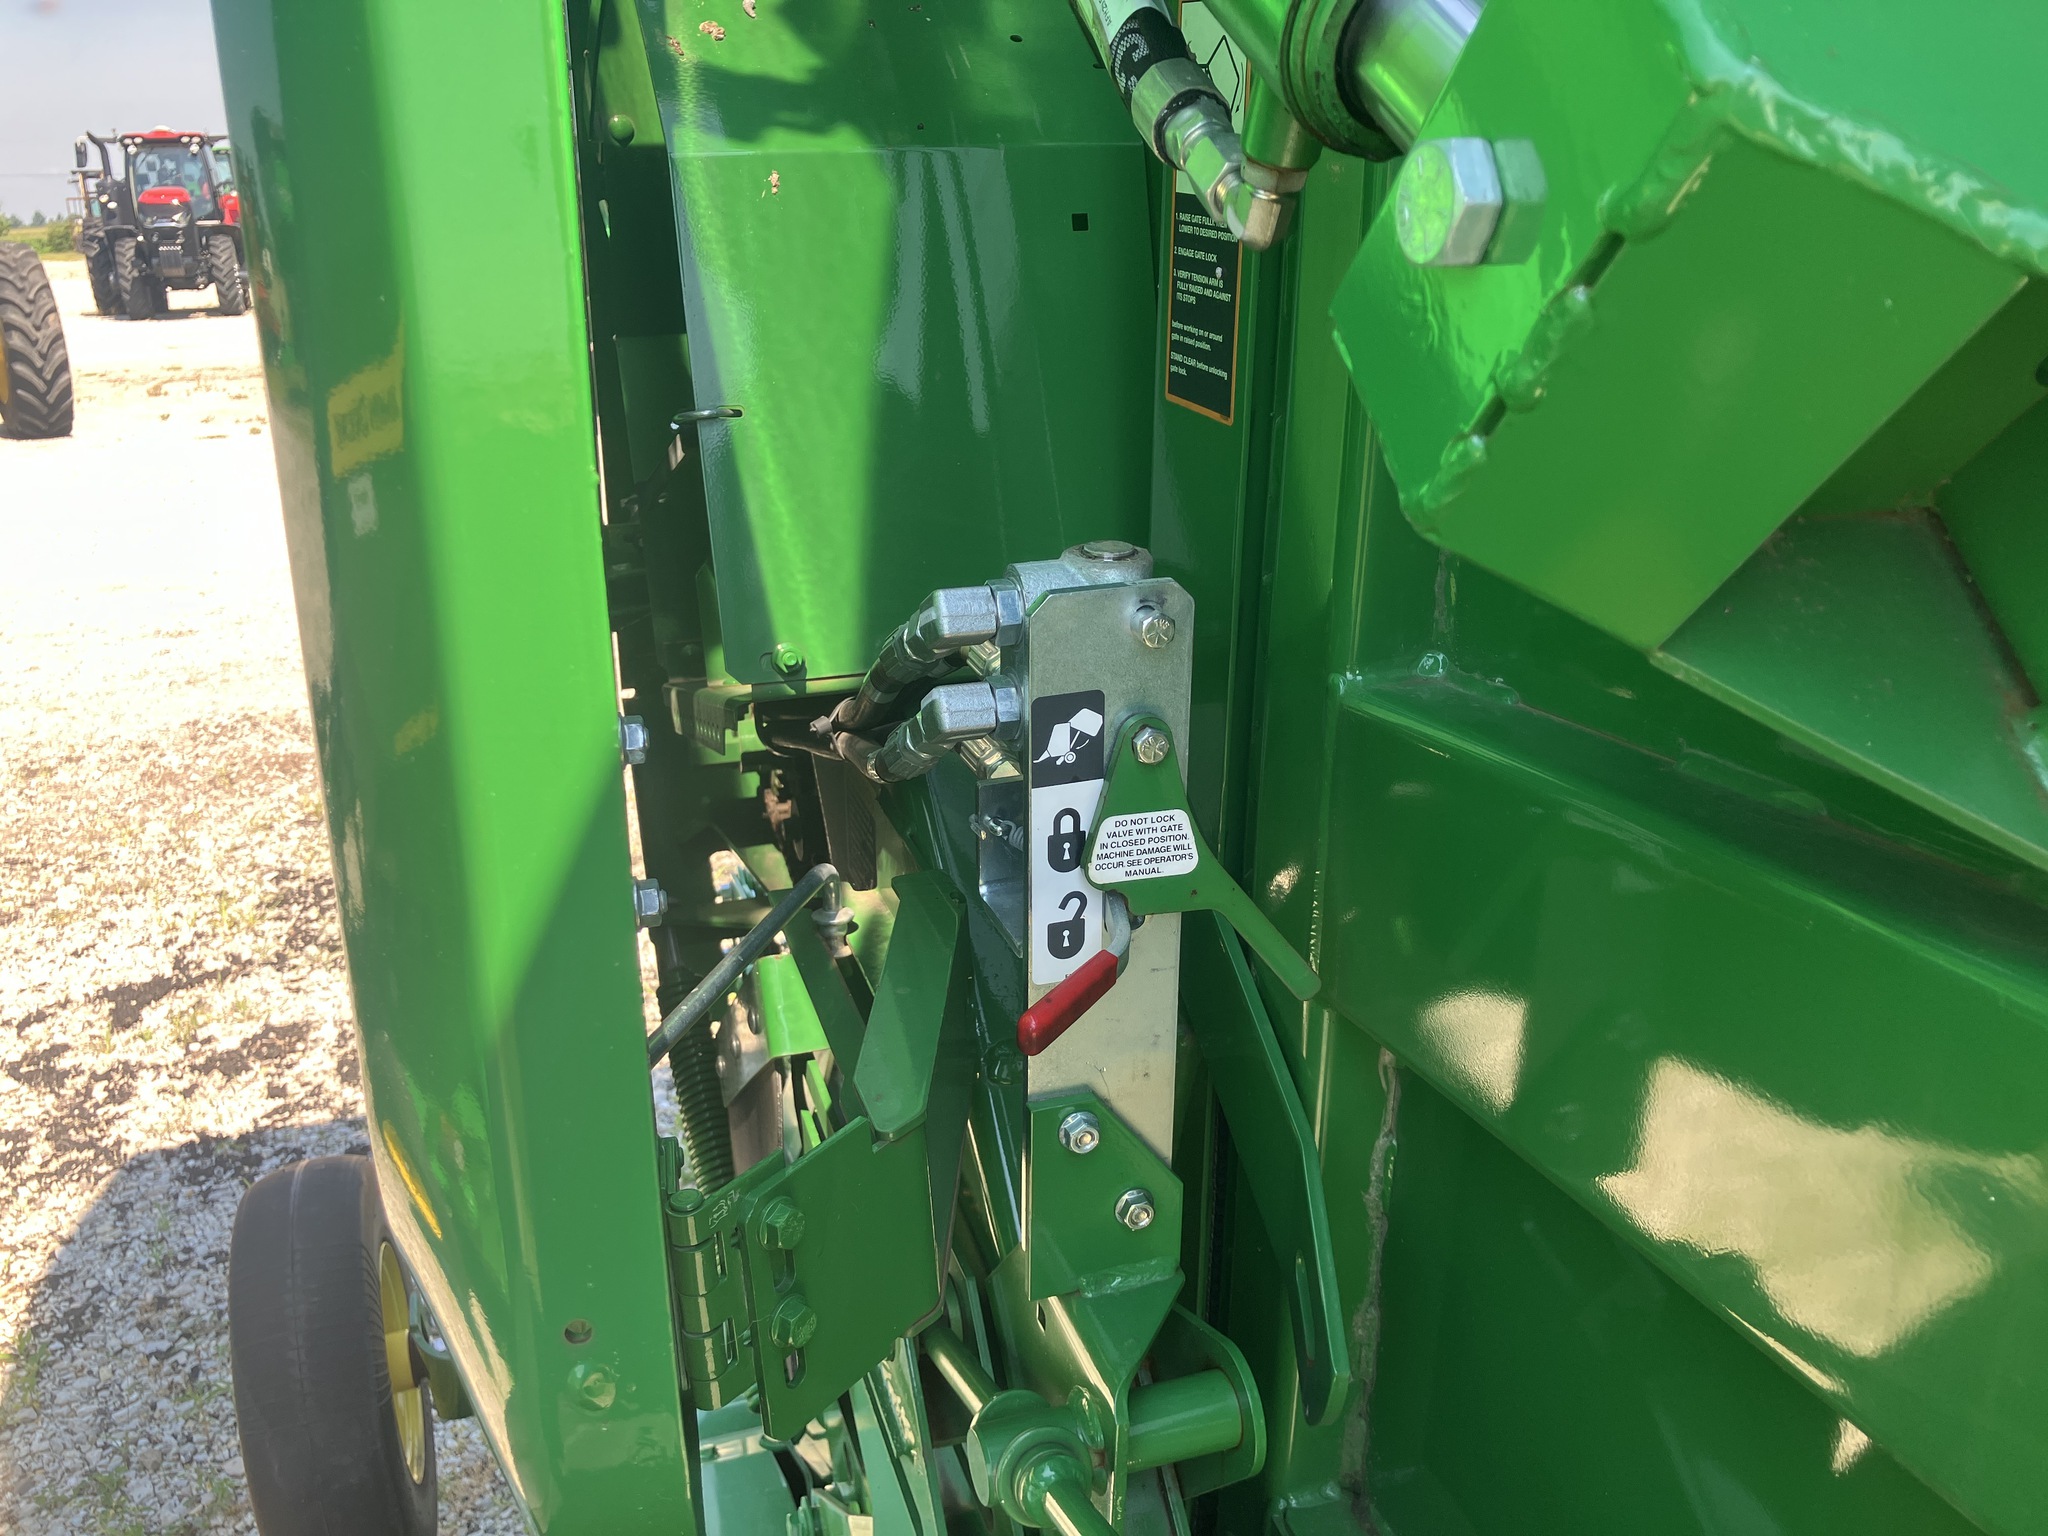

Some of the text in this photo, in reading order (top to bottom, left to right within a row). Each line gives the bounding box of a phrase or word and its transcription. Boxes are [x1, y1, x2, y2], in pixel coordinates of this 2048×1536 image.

[1180, 213, 1190, 222] RAISE
[1179, 224, 1193, 234] LOWER
[1194, 227, 1199, 235] TO
[1200, 228, 1217, 239] DESIRED
[1178, 247, 1194, 258] ENGAGE
[1195, 250, 1205, 260] GATE
[1206, 252, 1217, 262] LOCK
[1177, 269, 1191, 279] VERIFY
[1191, 272, 1208, 284] TENSION
[1209, 278, 1218, 286] ARM
[1219, 280, 1223, 288] IS
[1177, 281, 1231, 302] FULLY RAISED AND AGAINST
[1183, 294, 1196, 304] STOPS
[1172, 319, 1183, 329] before
[1184, 325, 1198, 336] working
[1209, 332, 1223, 342] around
[1184, 336, 1195, 345] raised
[1195, 340, 1212, 351] position.
[1170, 364, 1187, 376] gate lock.
[1171, 351, 1228, 380] STAND CLEAR before unlocking
[1130, 817, 1148, 826] NOT
[1151, 814, 1175, 824] LOCK
[1106, 824, 1183, 839] VALVE WITH GATE
[1110, 838, 1145, 849] CLOSED
[1148, 834, 1189, 845] POSITION.
[1096, 843, 1192, 860] MACHINE DAMAGE WILL
[1095, 853, 1194, 871] OCCUR. SEE OPERATOR'S
[1124, 867, 1164, 877] MANUAL.
